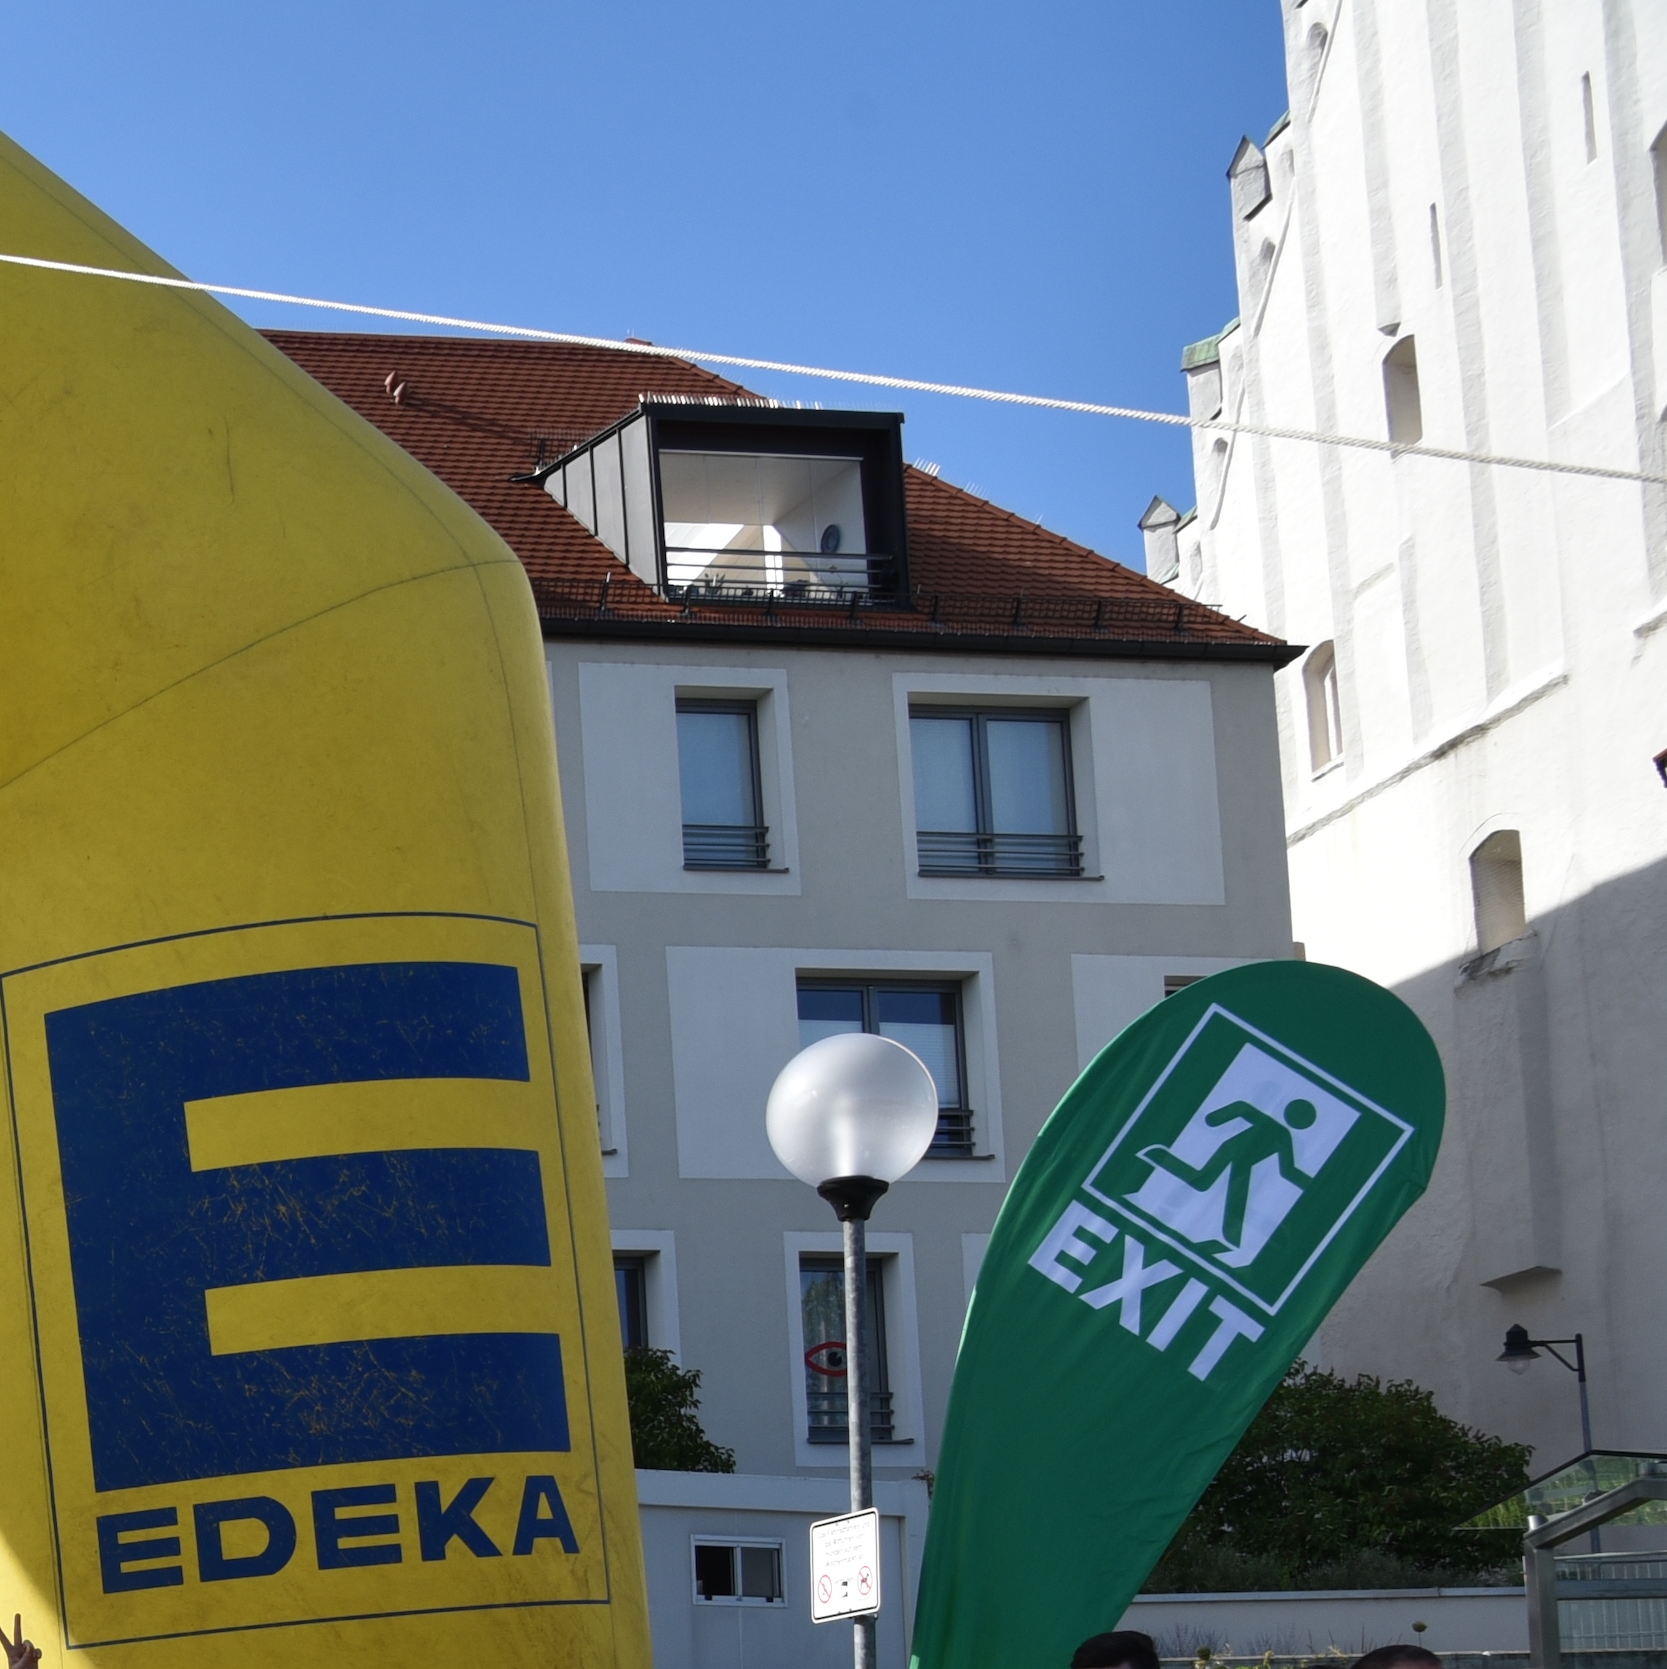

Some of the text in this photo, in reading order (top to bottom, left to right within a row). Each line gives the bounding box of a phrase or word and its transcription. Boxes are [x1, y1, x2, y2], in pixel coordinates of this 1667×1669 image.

[44, 962, 570, 1492] E
[1027, 1201, 1265, 1382] EXIT
[96, 1474, 580, 1594] EDEKA
